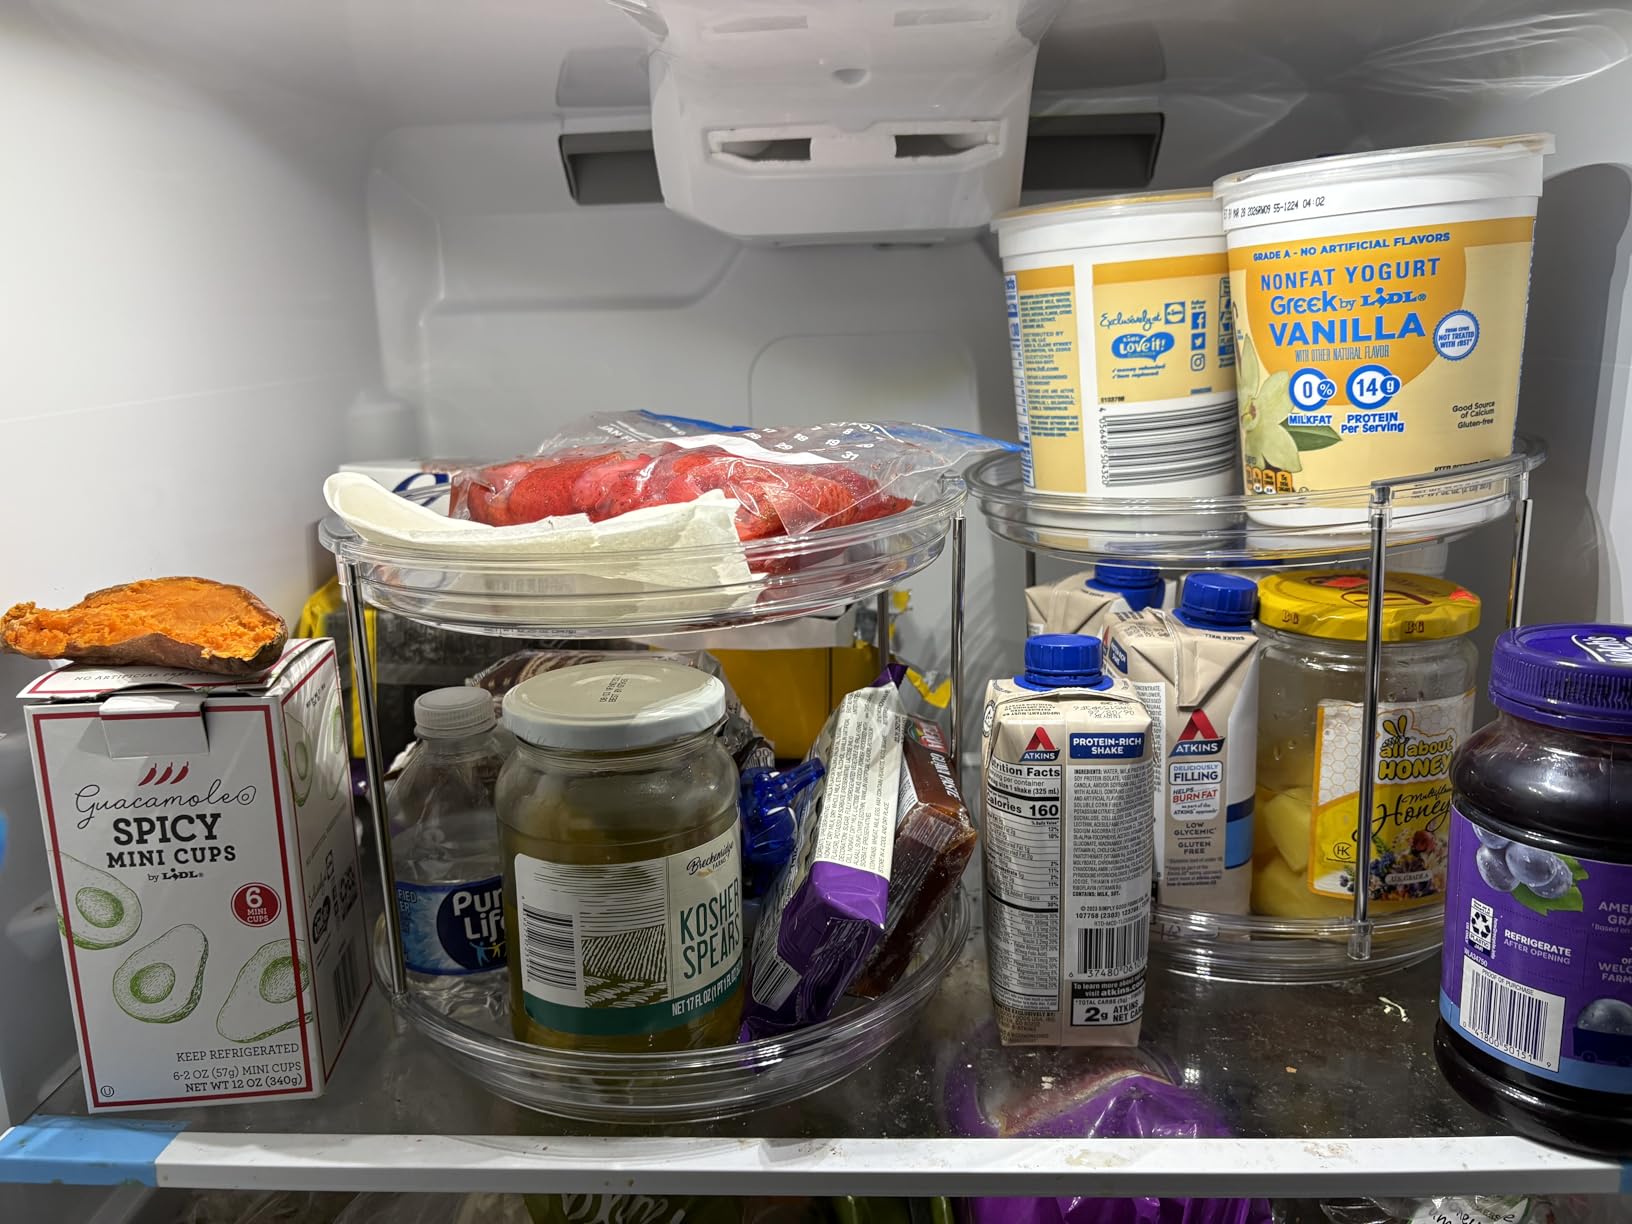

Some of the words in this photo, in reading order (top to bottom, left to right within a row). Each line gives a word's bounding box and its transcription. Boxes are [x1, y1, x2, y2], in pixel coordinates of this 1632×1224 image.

[1273, 200, 1299, 213] 55-1224
[1303, 196, 1325, 209] 04:02
[1253, 251, 1281, 262] GRADE
[1283, 249, 1291, 259] A
[1300, 246, 1317, 257] NO
[1320, 237, 1390, 256] ARTIFICIAL
[1394, 232, 1450, 247] FLAVORS
[1260, 268, 1336, 292] NONFAT
[1344, 257, 1441, 284] YOGURT
[1270, 290, 1338, 316] Greek
[1340, 297, 1356, 312] by
[1099, 309, 1152, 332] Exclusively
[1268, 312, 1426, 347] VANILLA
[1451, 331, 1475, 340] TREATED
[1119, 337, 1150, 355] Love
[1151, 337, 1166, 351] it!
[1440, 340, 1456, 349] WITH
[1295, 349, 1309, 363] WITH
[1311, 348, 1331, 362] OTHER
[1332, 346, 1363, 361] NATURAL
[1364, 344, 1390, 359] FLAVOR
[1356, 377, 1378, 398] 14
[1452, 404, 1473, 413] Good
[1474, 400, 1496, 410] Source
[1460, 411, 1469, 419] of
[1470, 408, 1495, 418] Calcium
[1288, 413, 1333, 426] MILKFAT
[1347, 411, 1399, 424] PROTEIN
[1457, 418, 1494, 429] Gluten-free
[1341, 422, 1358, 435] Per
[1359, 420, 1405, 435] Serving
[841, 451, 860, 461] 31
[95, 672, 159, 681] ARTIFICIAL
[1073, 737, 1142, 746] PROTEIN-RICH
[1175, 742, 1219, 753] ATKINS
[1379, 742, 1404, 758] all
[1406, 736, 1453, 757] about
[1023, 752, 1056, 760] ATKINS
[1091, 746, 1124, 755] SHAKE
[1026, 767, 1061, 777] Facts
[1173, 764, 1219, 772] DELICIOUSLY
[1377, 752, 1453, 781] HONEY
[1173, 771, 1219, 782] FILLING
[1013, 786, 1032, 794] shake
[1032, 788, 1047, 797] (325
[1172, 792, 1201, 804] BURN
[1201, 789, 1218, 799] FAT
[1173, 787, 1194, 795] HELPS
[75, 779, 256, 830] Guacamole
[1029, 803, 1059, 817] 160
[1352, 793, 1452, 842] Honey
[113, 813, 222, 846] SPICY
[106, 849, 166, 869] MINI
[180, 845, 236, 864] CUPS
[686, 840, 734, 876] Breckenridge
[147, 872, 159, 883] by
[245, 886, 263, 908] 6
[452, 887, 503, 917] Pur
[247, 908, 268, 916] MINI
[679, 877, 740, 945] KOSHER
[1598, 901, 1632, 914] AME
[246, 914, 269, 924] CUPS
[463, 909, 505, 943] Lif
[682, 912, 740, 980] SPEARS
[1470, 935, 1490, 949] PLASTIC
[1504, 929, 1572, 957] REFRIGERATE
[1503, 938, 1529, 953] AFTER
[1530, 949, 1571, 965] OPENING
[1087, 967, 1120, 978] 37480
[1598, 961, 1632, 974] WELC
[1482, 968, 1497, 979] PROOF
[1505, 980, 1534, 996] PURCHASE
[1601, 972, 1632, 984] FARM
[1082, 982, 1100, 990] learn
[1101, 982, 1118, 990] more
[1085, 990, 1100, 998] visit
[671, 999, 687, 1017] NET
[686, 997, 695, 1012] 17
[695, 995, 703, 1009] FL
[703, 989, 712, 1004] OZ
[1113, 1000, 1139, 1014] ATKINS
[1112, 1012, 1129, 1023] NET
[176, 1050, 207, 1063] KEEP
[209, 1043, 300, 1060] REFRIGERATED
[1474, 1029, 1499, 1048] 41800
[1503, 1043, 1534, 1062] 50151
[173, 1071, 190, 1081] 6-2
[192, 1069, 209, 1079] OZ
[211, 1065, 240, 1080] (57g)
[242, 1063, 271, 1076] MINI
[273, 1061, 302, 1074] CUPS
[185, 1081, 208, 1093] NET
[208, 1080, 230, 1092] WT
[232, 1078, 245, 1090] 12
[246, 1077, 263, 1088] OZ
[265, 1074, 303, 1089] (340g)
